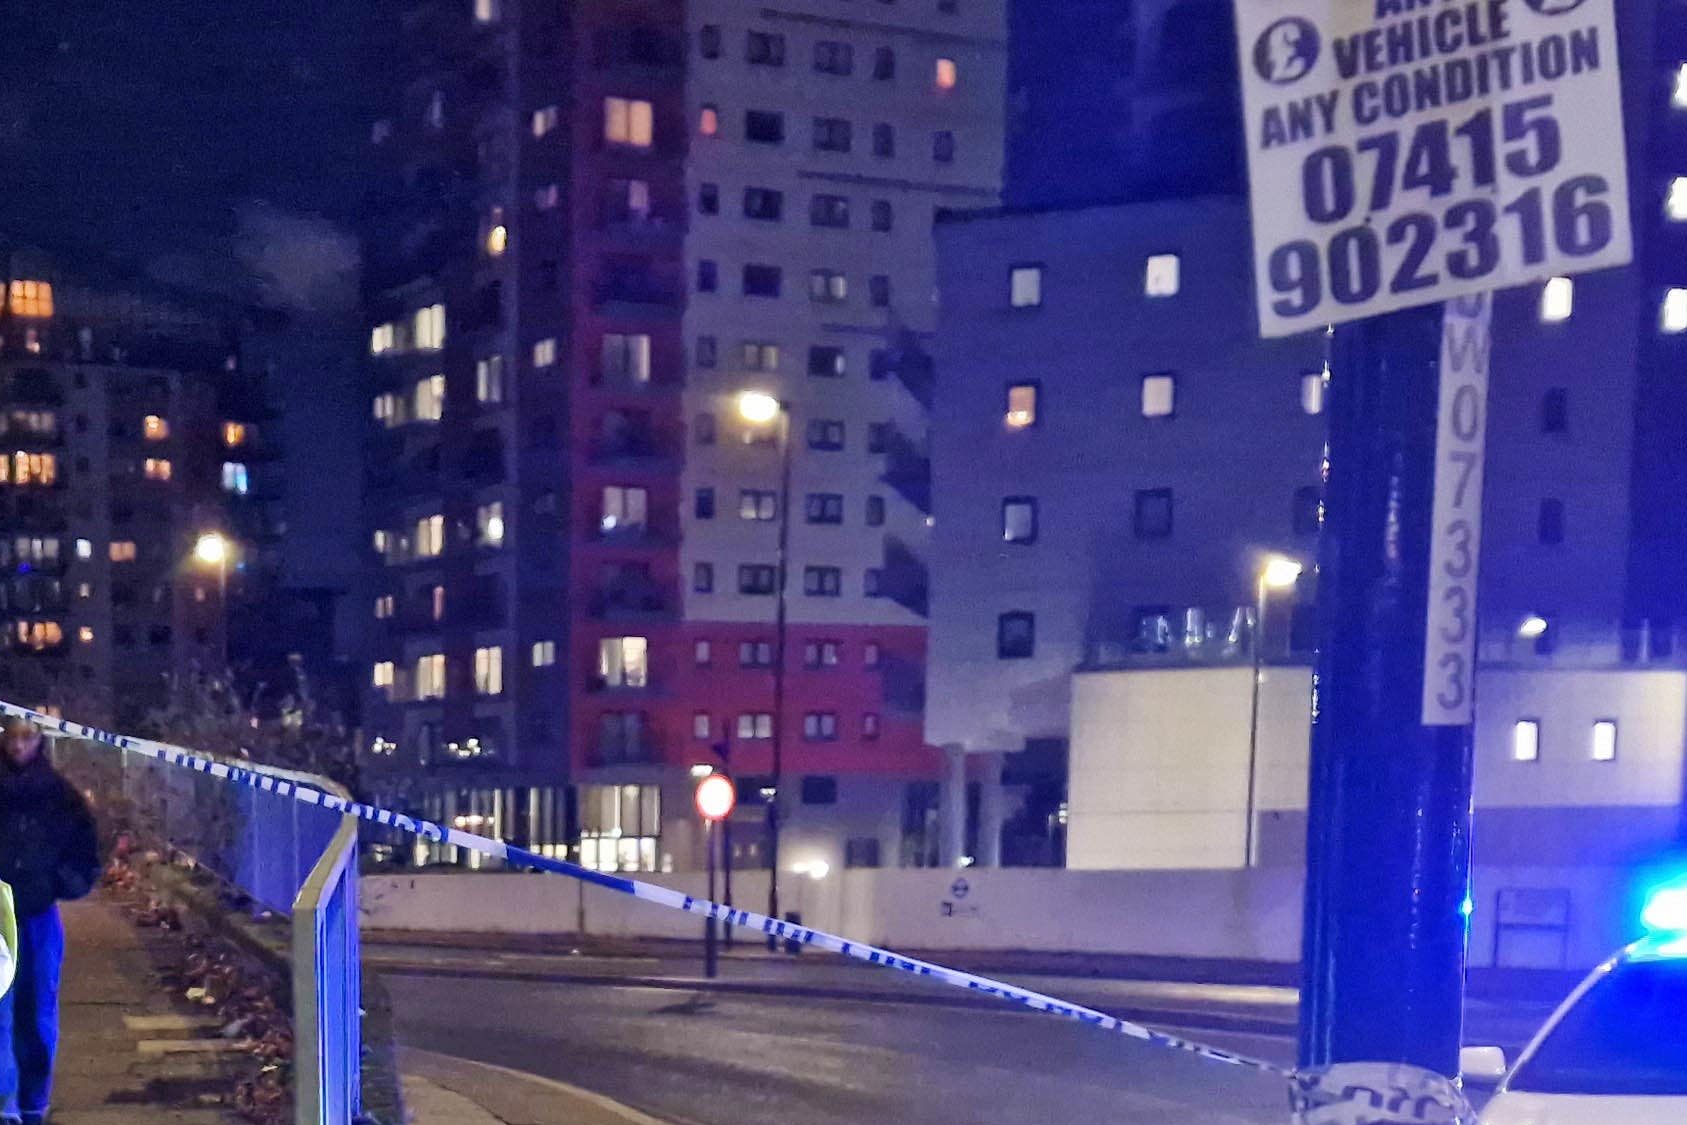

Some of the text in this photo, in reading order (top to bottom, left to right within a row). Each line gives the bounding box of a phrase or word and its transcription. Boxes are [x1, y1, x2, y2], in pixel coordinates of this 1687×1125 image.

[1260, 26, 1599, 150] ANY CONDITION
[1332, 0, 1511, 80] VEHICLE
[1302, 95, 1562, 224] 07415
[1268, 175, 1613, 318] 902316
